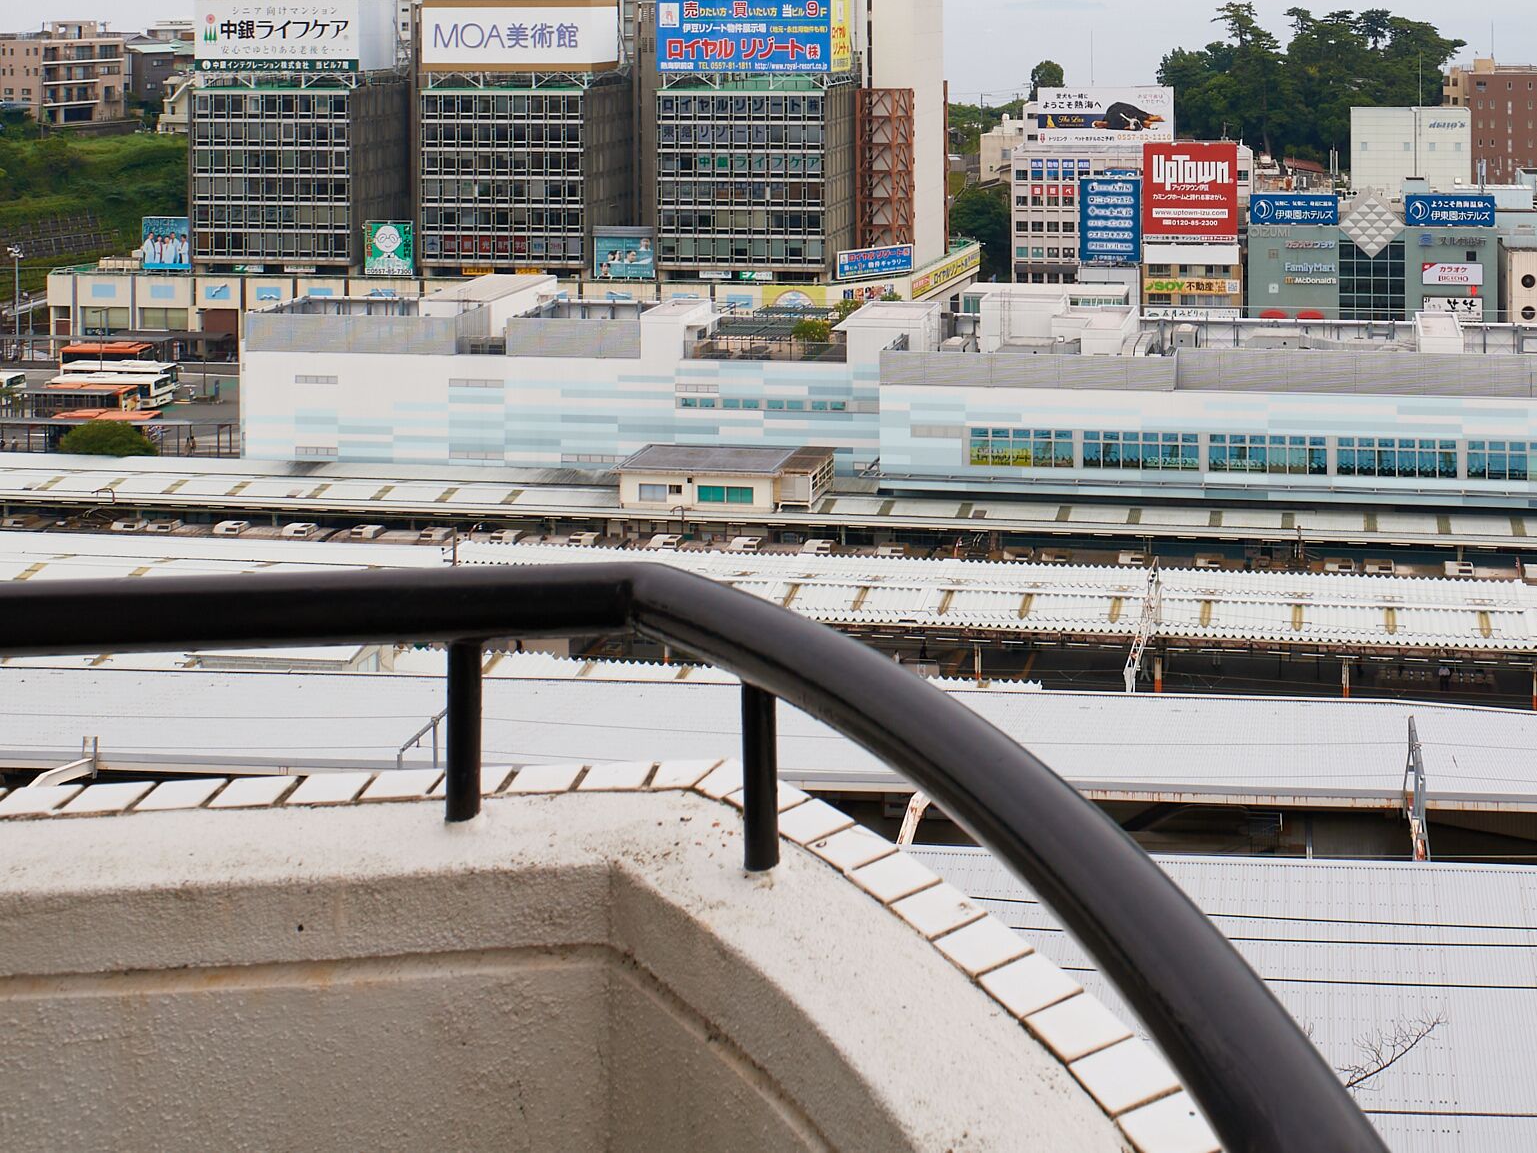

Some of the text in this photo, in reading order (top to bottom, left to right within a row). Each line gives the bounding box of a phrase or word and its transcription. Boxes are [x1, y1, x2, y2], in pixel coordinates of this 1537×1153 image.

[232, 6, 338, 16] シニア向けマンション
[220, 19, 349, 40] 中銀ライフケア
[433, 22, 579, 49] MOA美術館
[698, 62, 709, 70] TEL
[662, 125, 764, 138] 東急リゾート
[1152, 154, 1229, 191] UpTown
[1275, 209, 1334, 220] 伊東園ホテルズ
[1430, 210, 1491, 221] 伊東園ホテルズ
[1284, 262, 1336, 274] FamilyMart
[1294, 277, 1337, 285] McDonald's
